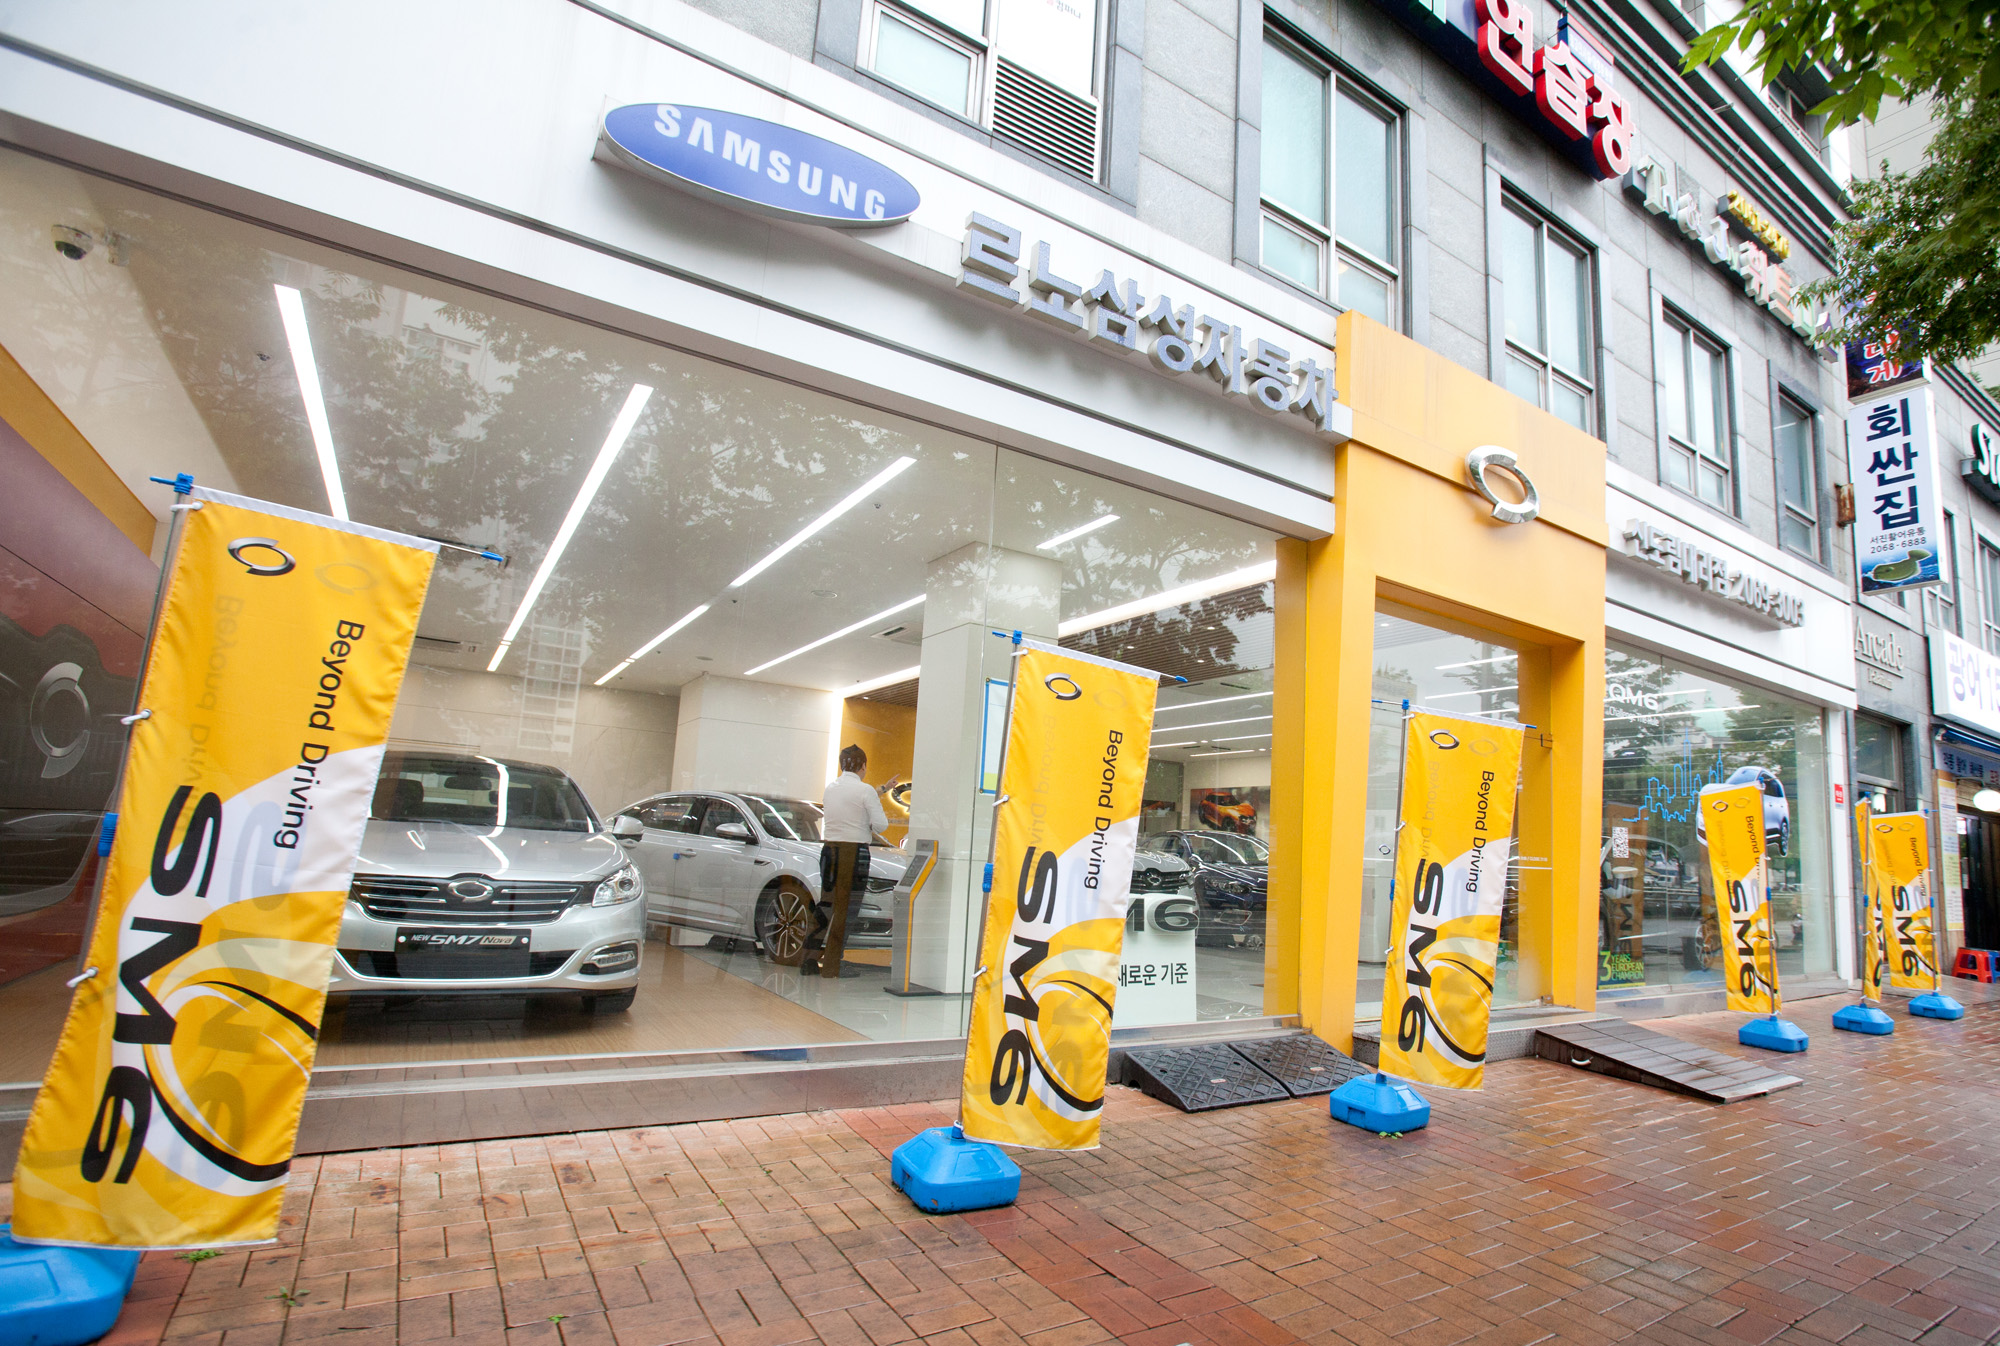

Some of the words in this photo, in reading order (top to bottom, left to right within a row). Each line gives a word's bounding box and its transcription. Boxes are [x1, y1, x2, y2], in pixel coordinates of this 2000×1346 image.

[1478, 0, 1636, 178] 연습장
[653, 103, 887, 222] SAMSUNG
[957, 209, 1339, 434] 르노삼성자동차
[1866, 397, 1919, 531] 회싼집
[1870, 536, 1927, 554] 2068-6888
[1730, 569, 1805, 627] 2069-3003
[306, 619, 365, 732] Beyond
[1855, 616, 1905, 671] Arcade
[1949, 641, 1983, 710] 광어
[1608, 683, 1659, 711] QM6
[273, 743, 330, 851] Driving
[1097, 729, 1124, 809] Beyond
[1474, 770, 1495, 831] Beyond
[1084, 815, 1112, 891] Driving
[1465, 835, 1488, 893] Driving
[1745, 815, 1760, 854] Beyond
[1909, 837, 1923, 867] Beyond
[427, 934, 484, 945] SM7
[483, 935, 513, 944] Nova
[1397, 859, 1444, 1053] SM6
[1599, 951, 1612, 981] 3
[1726, 879, 1757, 998] SM6
[1892, 885, 1920, 977] SM6
[81, 783, 223, 1184] SM6
[989, 845, 1059, 1106] SM6
[1161, 962, 1188, 985] 기준
